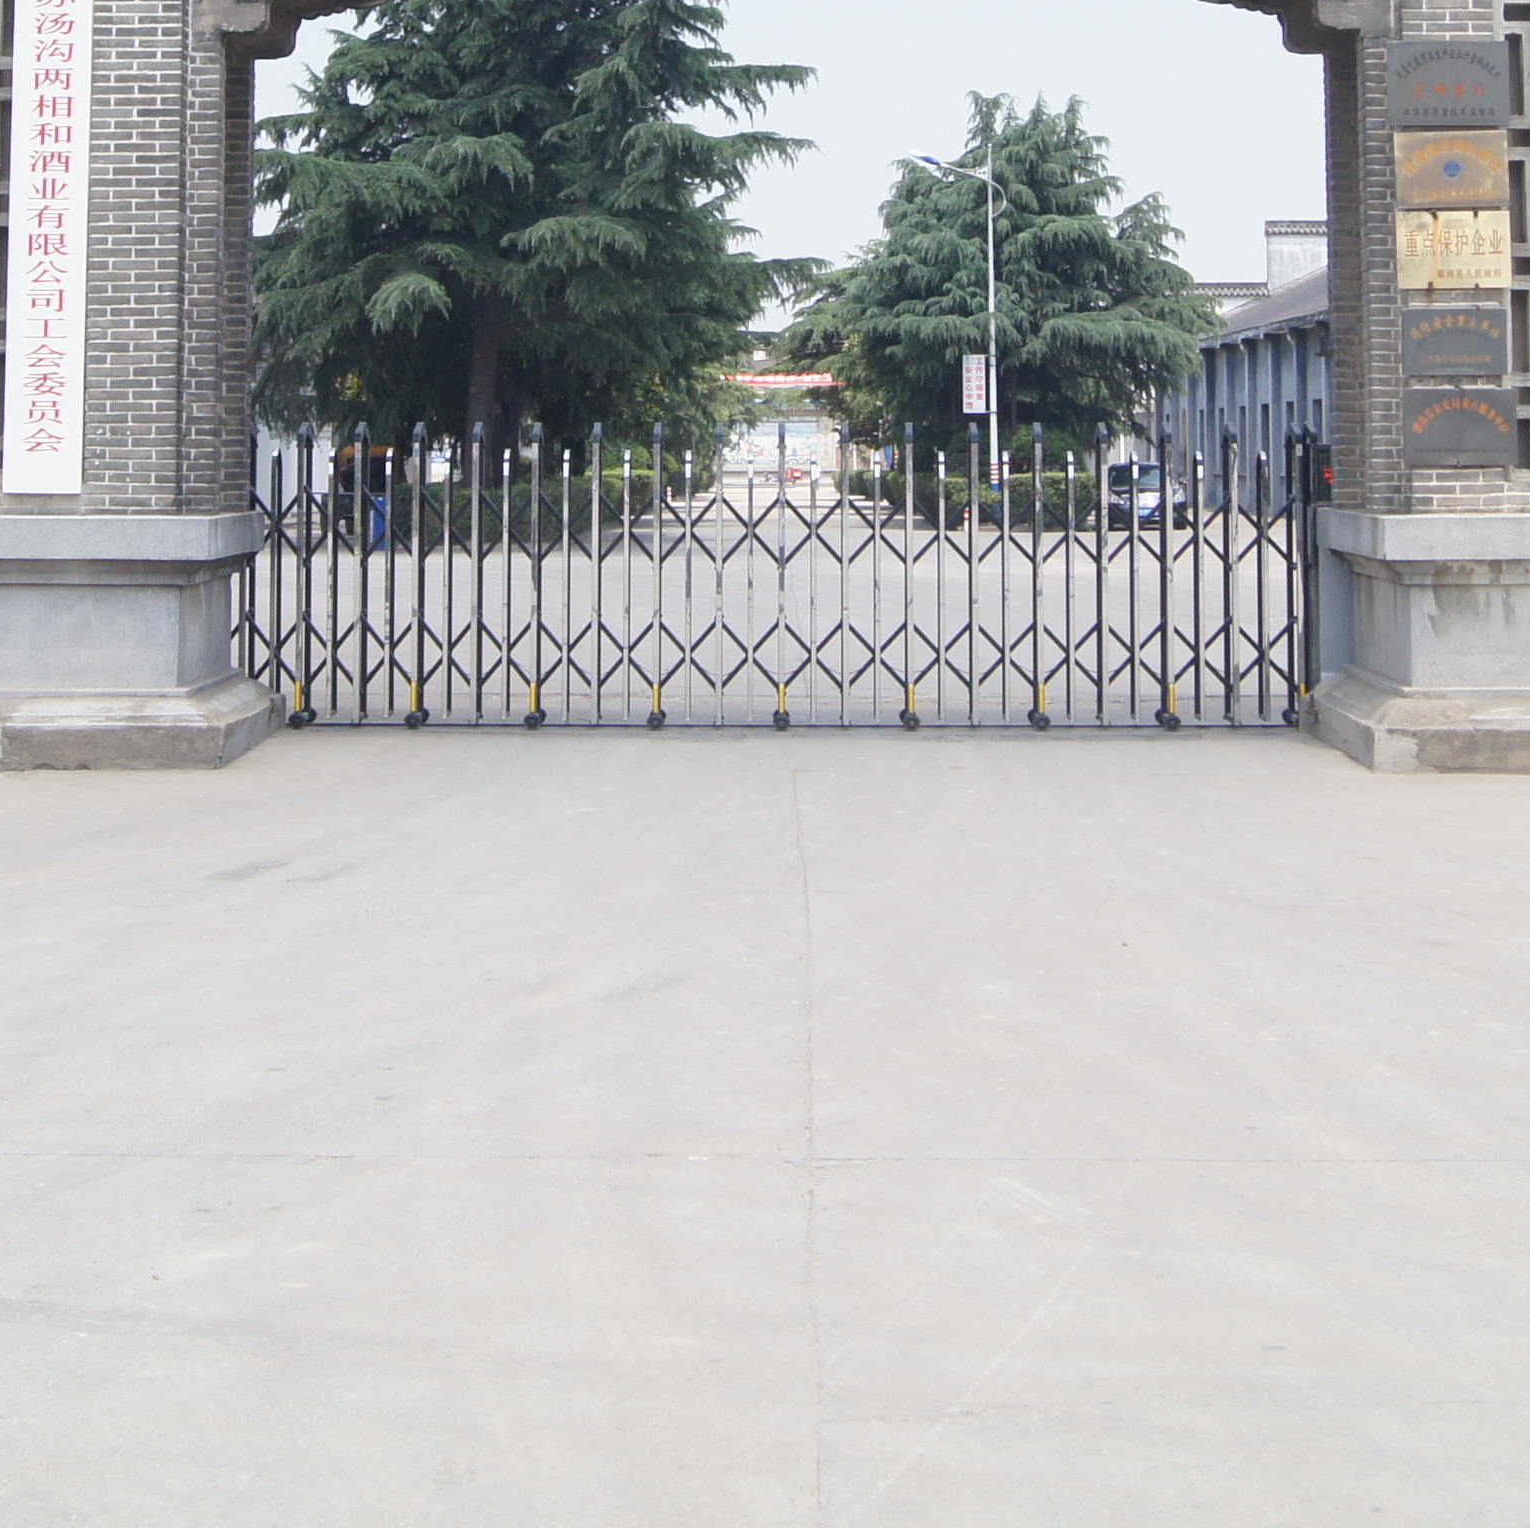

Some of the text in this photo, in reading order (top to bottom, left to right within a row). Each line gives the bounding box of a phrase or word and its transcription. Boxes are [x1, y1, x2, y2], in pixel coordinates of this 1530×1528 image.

[1404, 228, 1504, 257] 重点保护企业
